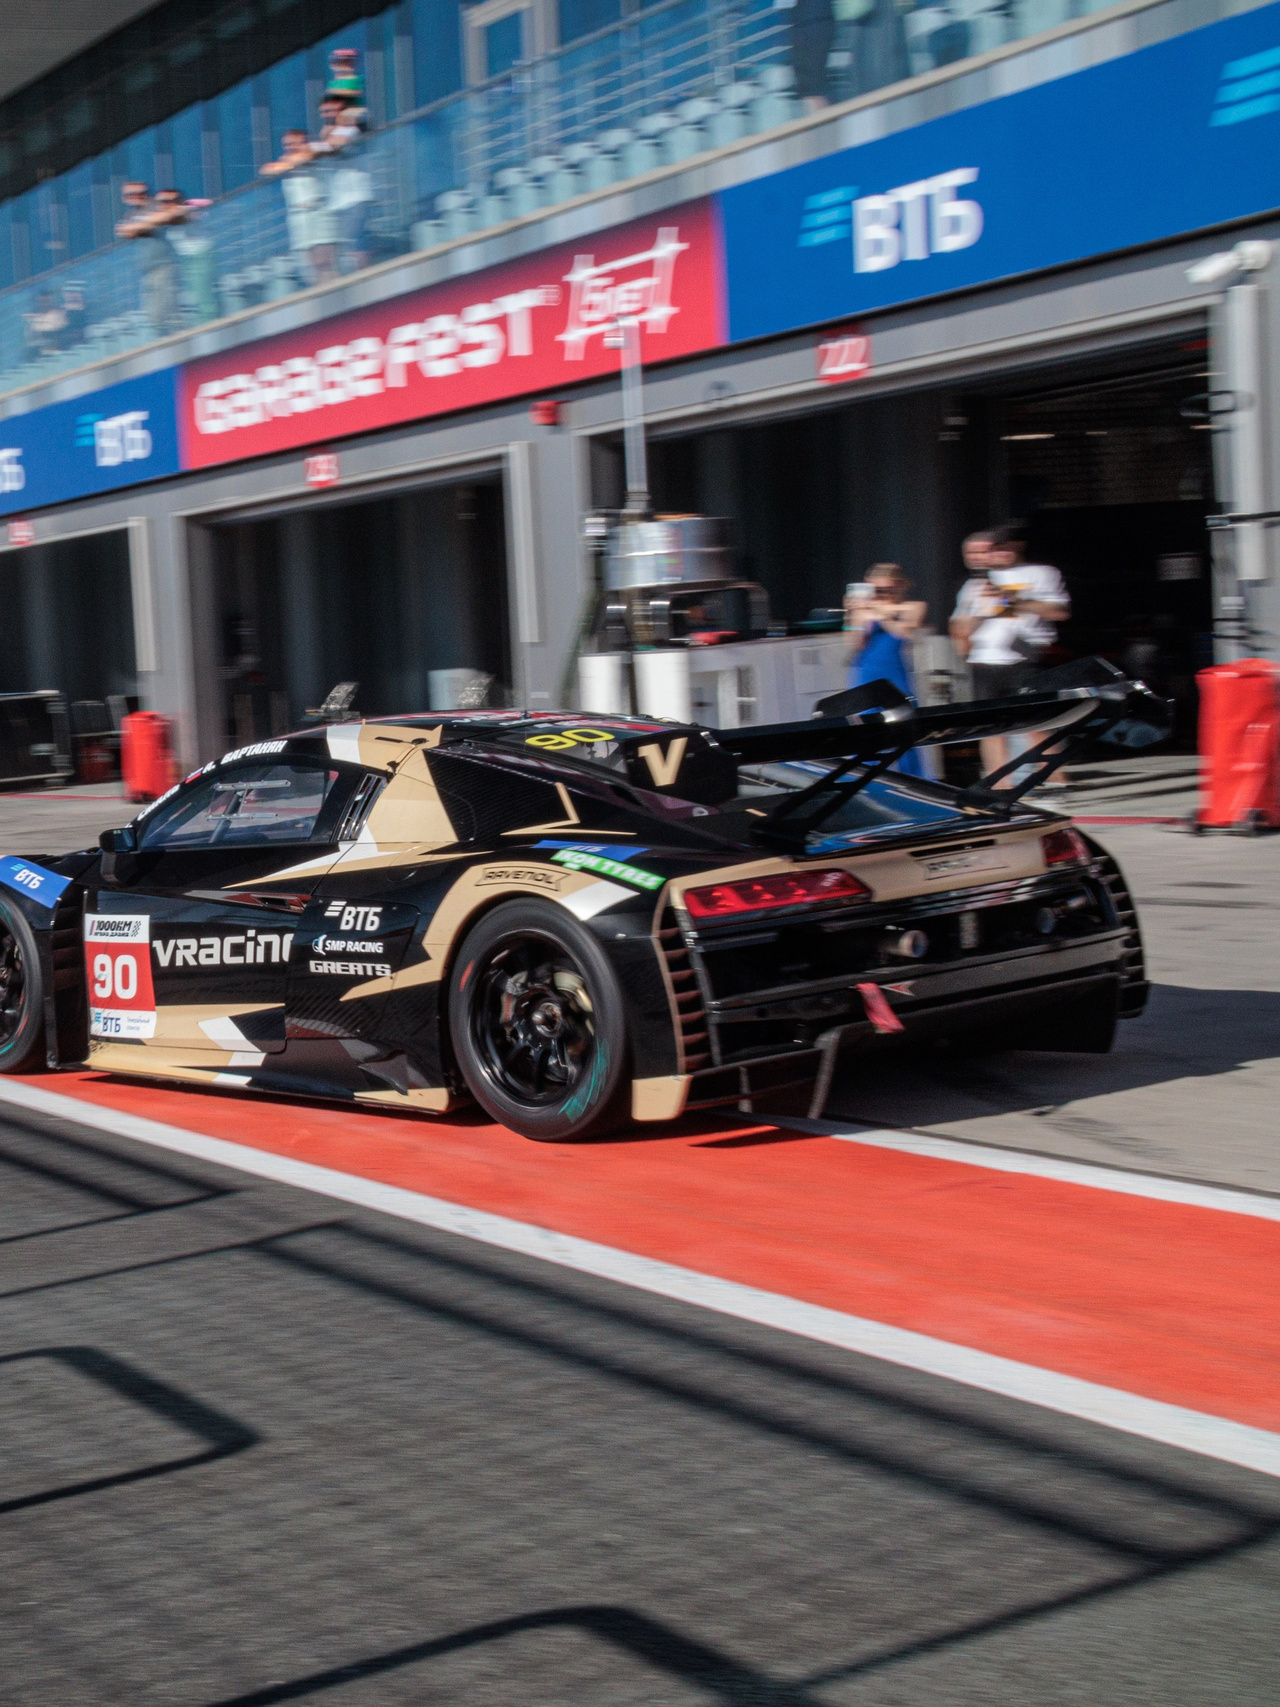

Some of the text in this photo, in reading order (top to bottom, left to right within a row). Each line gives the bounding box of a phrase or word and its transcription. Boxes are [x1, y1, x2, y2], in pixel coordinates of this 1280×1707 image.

[851, 167, 984, 274] ВТБ
[94, 411, 152, 466] ВТБ
[525, 728, 615, 750] 90
[220, 740, 288, 765] ВАРТАНЯН
[13, 869, 45, 889] ВТБ
[484, 870, 555, 884] RAVENOL
[601, 860, 662, 888] TYRES
[339, 906, 383, 931] ВТБ
[325, 940, 384, 954] SMP RACING
[93, 953, 138, 999] 90
[309, 960, 392, 977] GREATS
[102, 1016, 121, 1033] ВТБ
